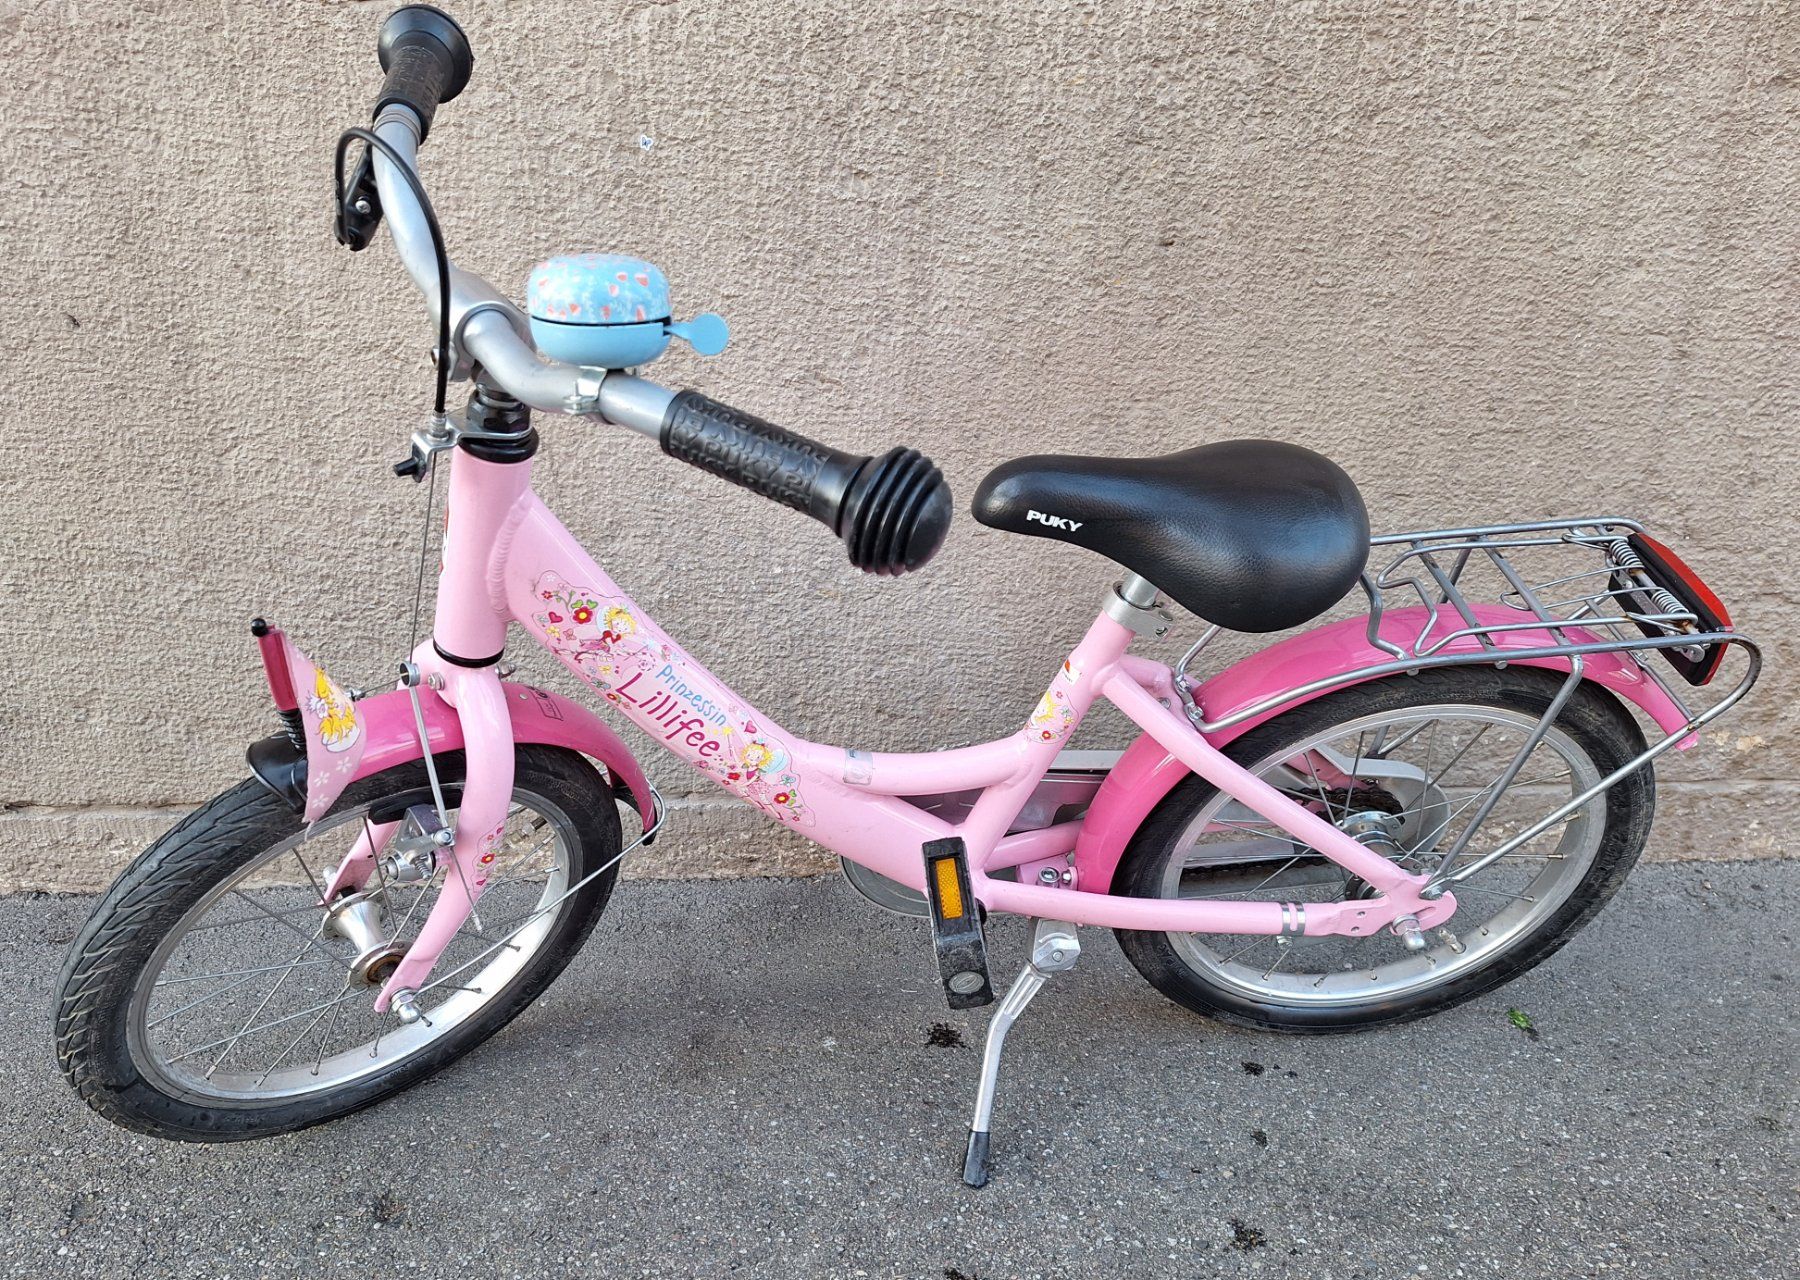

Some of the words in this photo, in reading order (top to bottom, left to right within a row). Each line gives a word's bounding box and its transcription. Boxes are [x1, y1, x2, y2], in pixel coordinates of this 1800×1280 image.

[1026, 509, 1083, 532] PUKY
[615, 672, 720, 757] Lillifee
[656, 664, 728, 727] Prinzessin
